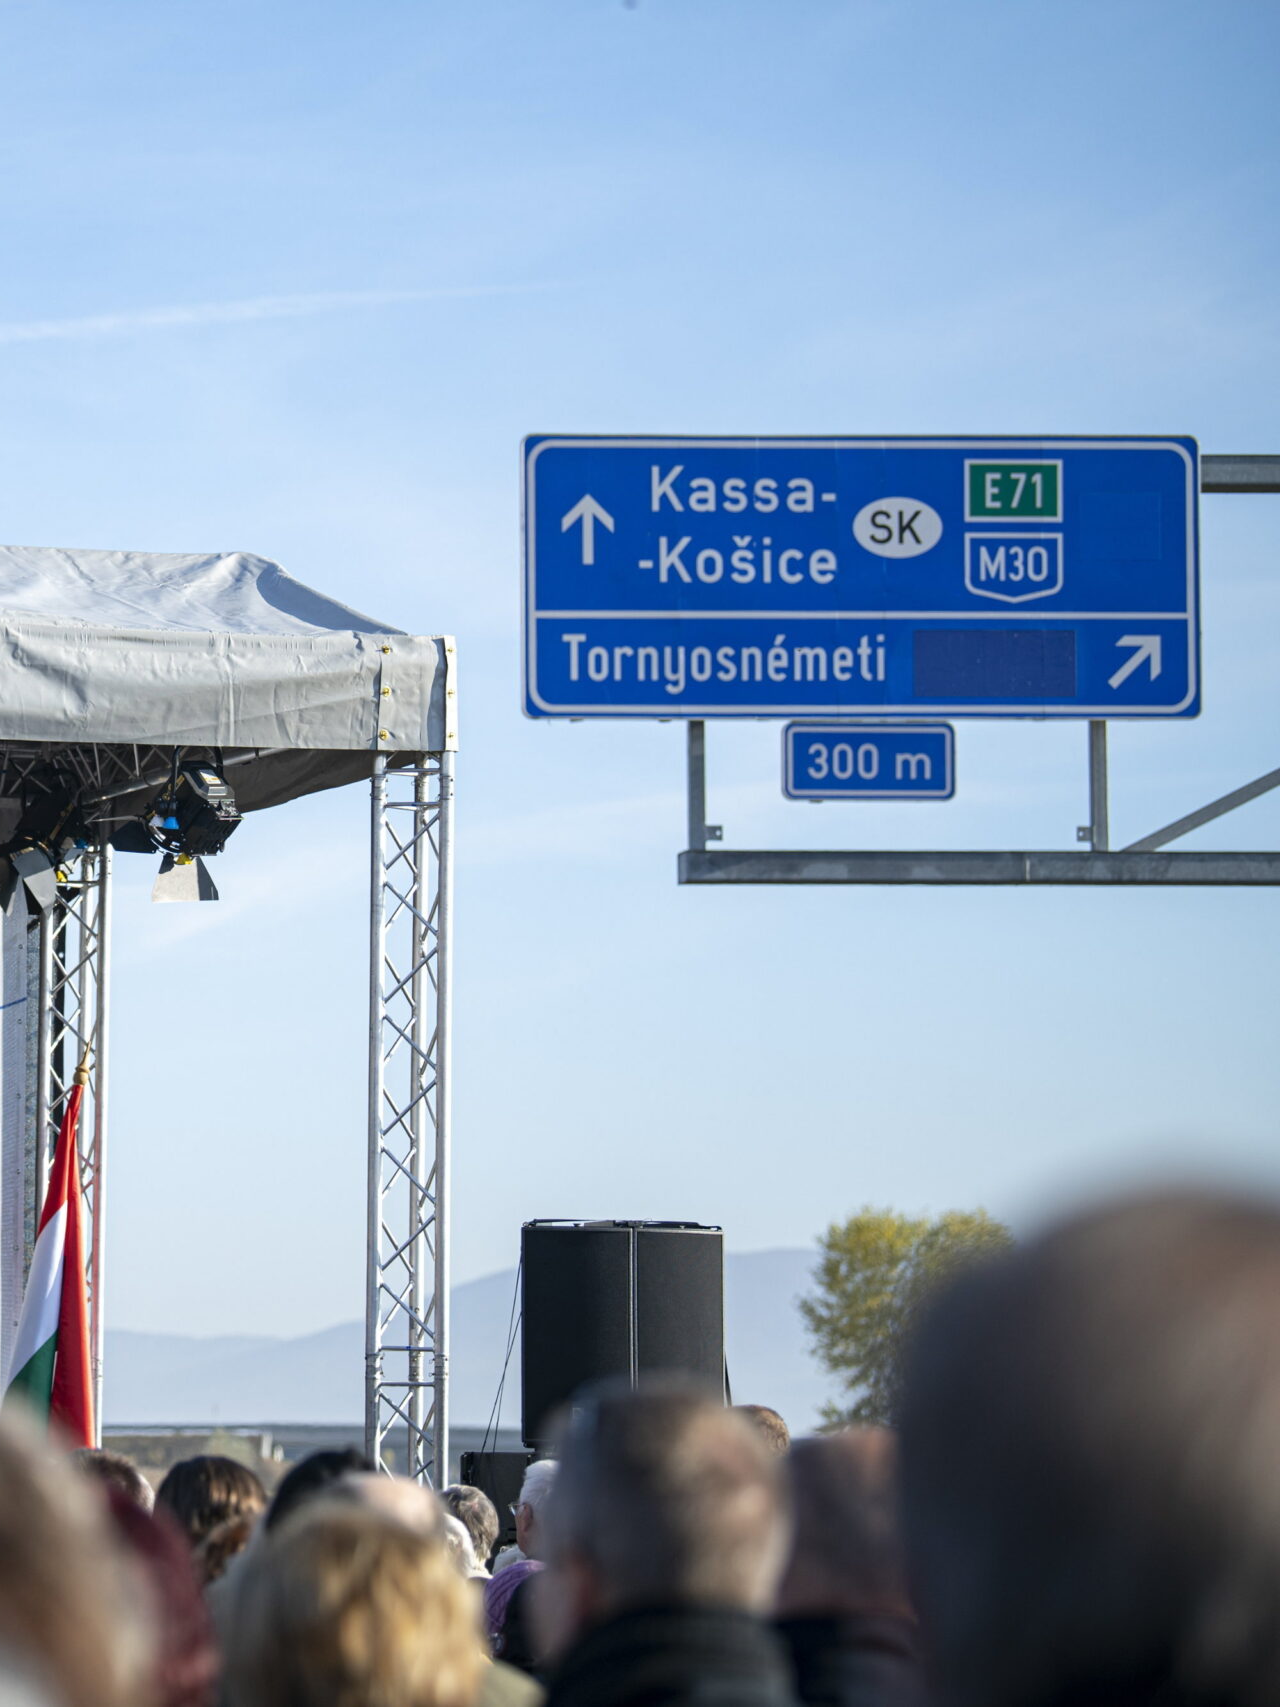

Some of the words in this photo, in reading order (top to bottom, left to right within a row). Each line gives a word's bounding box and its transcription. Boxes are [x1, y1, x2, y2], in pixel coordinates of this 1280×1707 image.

[651, 465, 837, 512] Kassa-
[985, 473, 1001, 508] E
[1010, 473, 1043, 508] 71
[869, 509, 922, 545] SK
[638, 535, 837, 584] -Košice
[979, 546, 1048, 582] M30
[562, 634, 885, 695] Tornyosnémeti
[808, 744, 878, 780] 300
[896, 754, 931, 780] m
